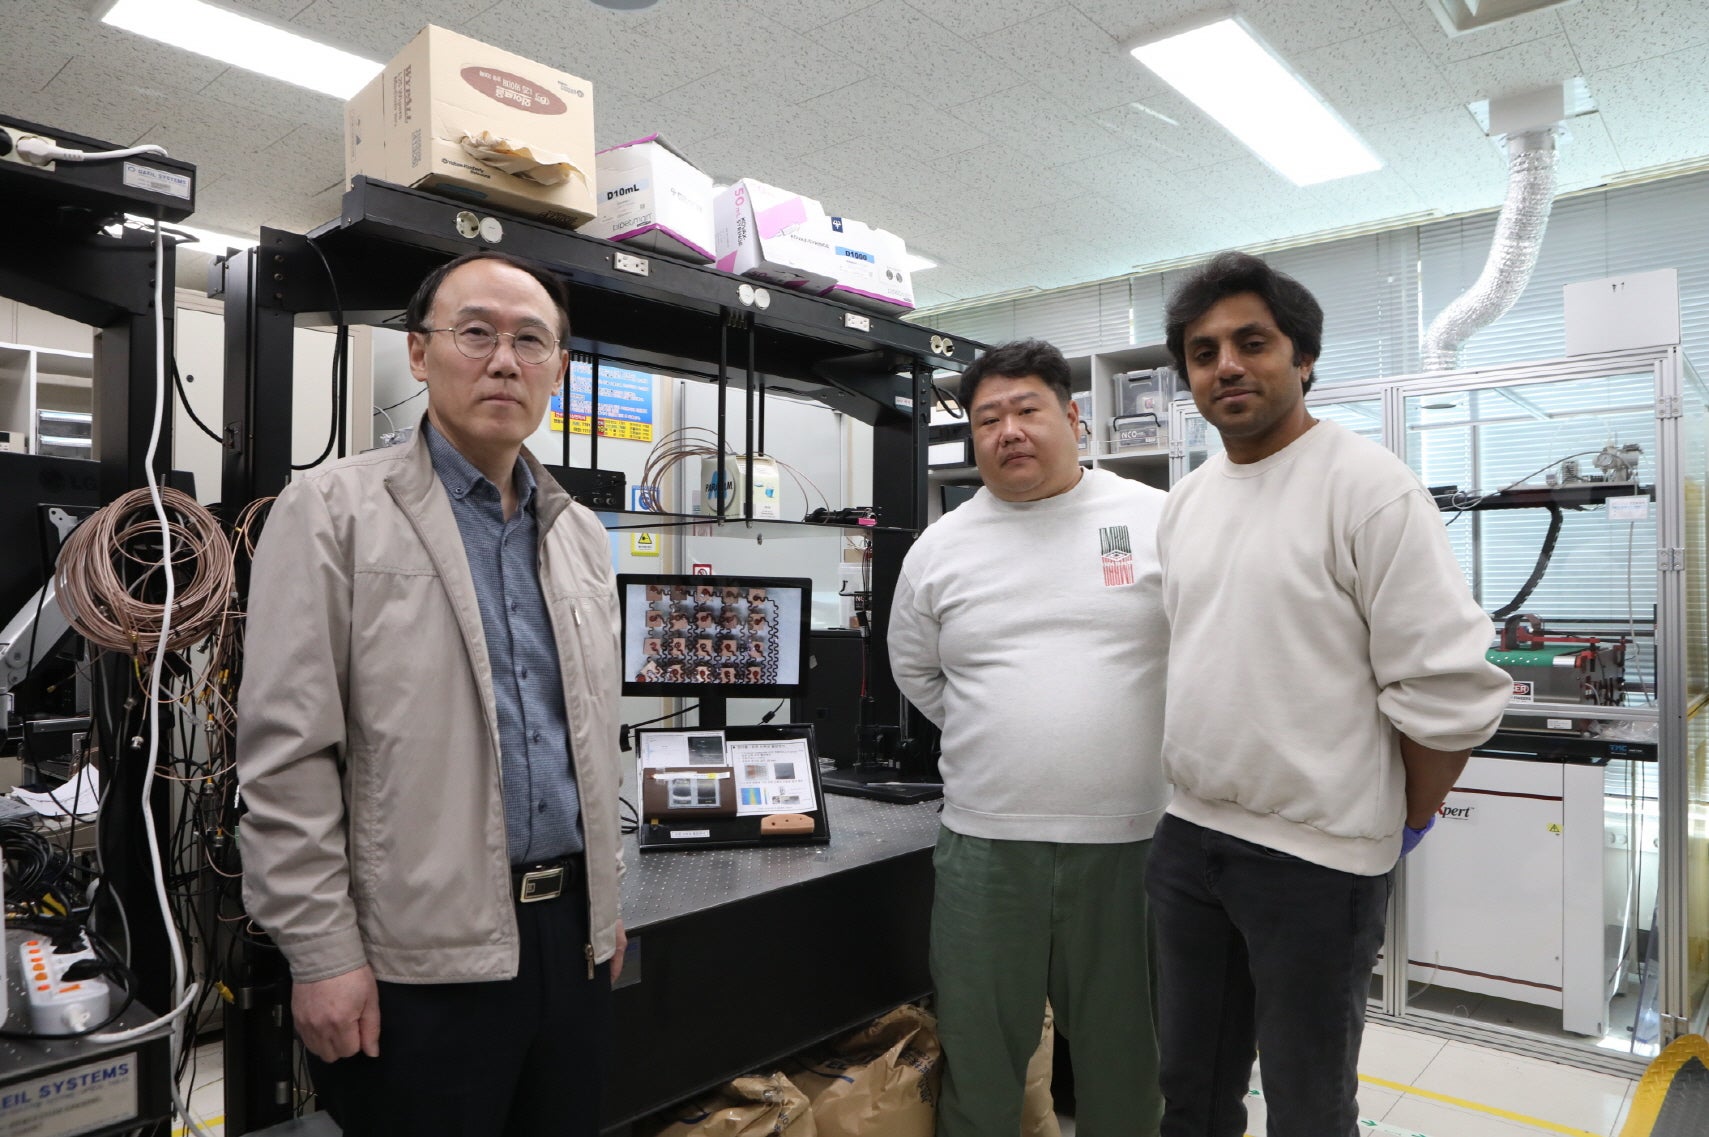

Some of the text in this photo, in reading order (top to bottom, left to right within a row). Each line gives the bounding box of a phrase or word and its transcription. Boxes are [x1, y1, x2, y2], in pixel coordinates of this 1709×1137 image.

[607, 184, 640, 200] D10mL
[734, 187, 745, 206] 50
[845, 250, 868, 261] D1000
[39, 1063, 129, 1098] SYSTEMS
